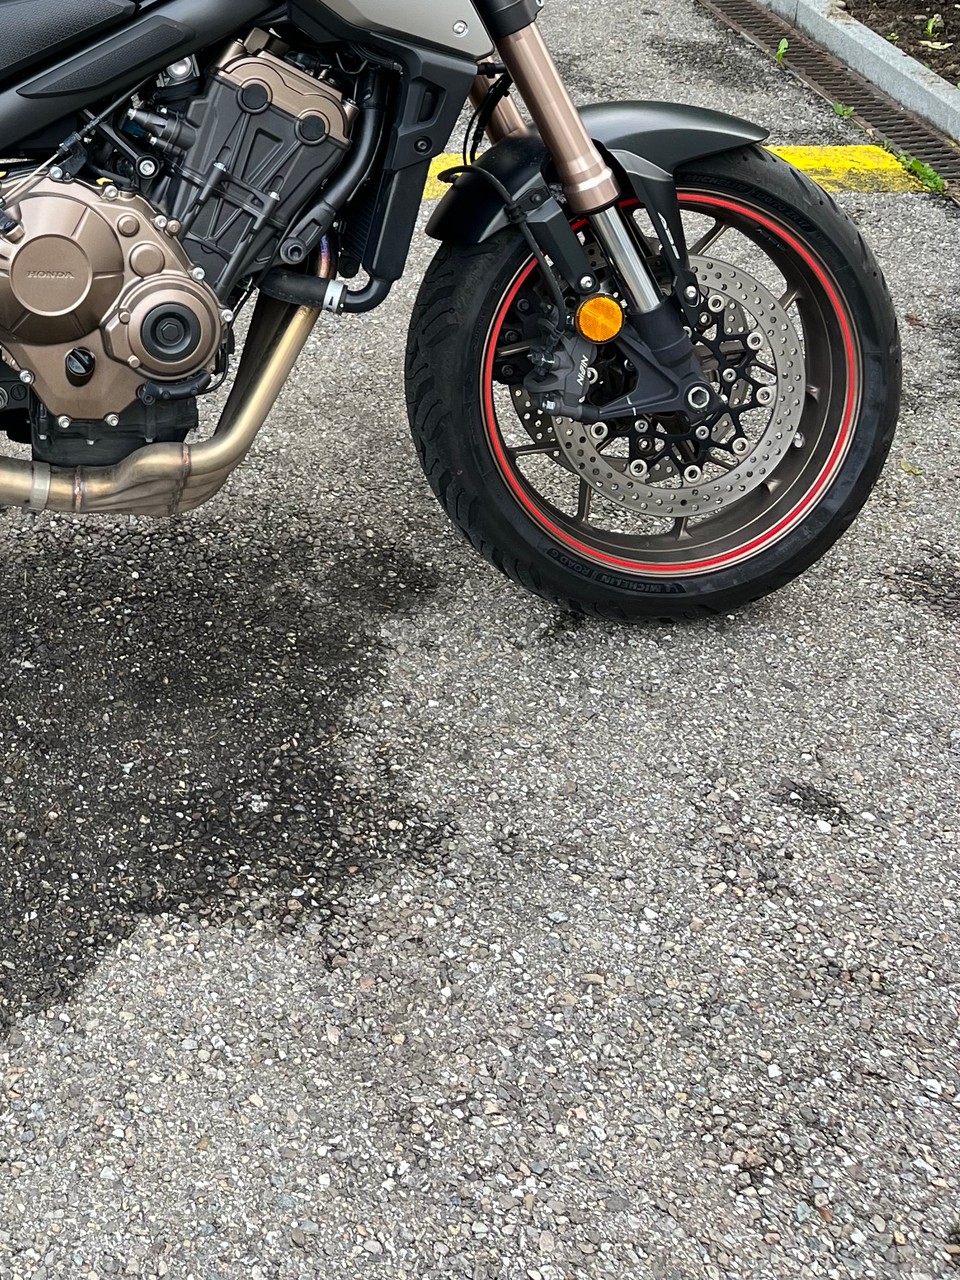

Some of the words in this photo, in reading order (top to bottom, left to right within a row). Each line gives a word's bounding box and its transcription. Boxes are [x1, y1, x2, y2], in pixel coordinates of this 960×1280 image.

[684, 174, 747, 194] MICHELIN
[27, 270, 75, 279] HONDA
[558, 555, 590, 577] ROAD
[600, 574, 662, 593] MICHELIN
